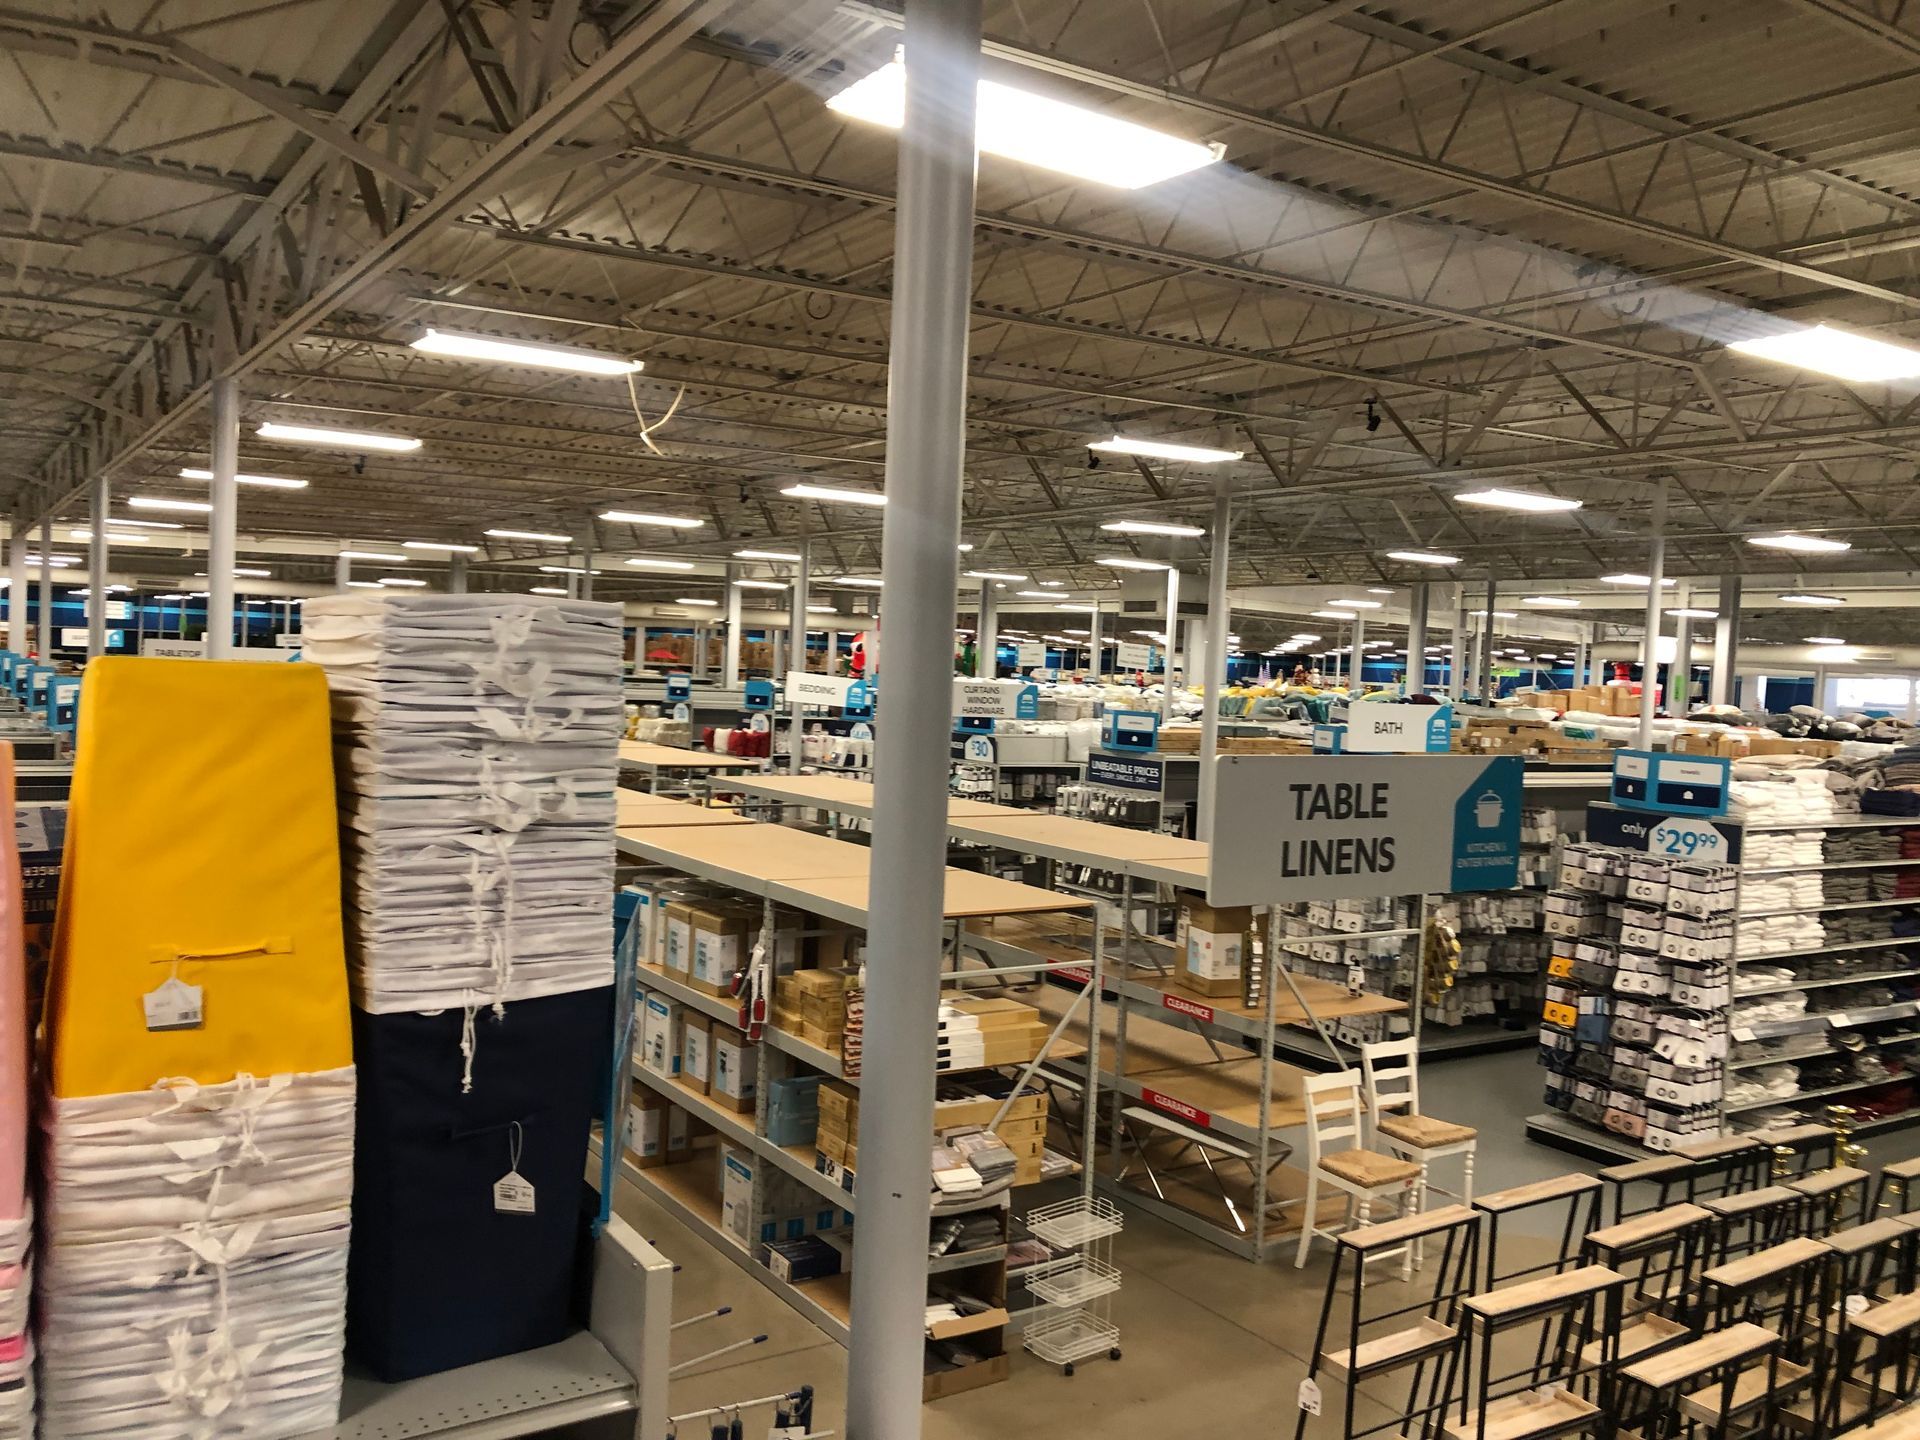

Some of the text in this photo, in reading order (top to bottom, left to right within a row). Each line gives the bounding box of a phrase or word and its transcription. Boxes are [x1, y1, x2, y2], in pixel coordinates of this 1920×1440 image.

[154, 648, 201, 658] TABLETOP
[799, 683, 836, 695] BEDDING
[963, 685, 1000, 694] CURTAINS
[967, 696, 1002, 705] WINDOW
[962, 706, 1005, 715] HARDWARE
[1374, 721, 1404, 734] BATH
[971, 740, 988, 757] $30
[1091, 760, 1159, 777] UNBEATABLE PRICES
[1288, 782, 1390, 820] TABLE
[1621, 823, 1647, 838] only
[1281, 837, 1396, 878] LINENS
[1456, 855, 1514, 869] ENTERTAINING
[1166, 998, 1210, 1019] CLEARANCE
[1153, 1094, 1197, 1119] CLEARANCE
